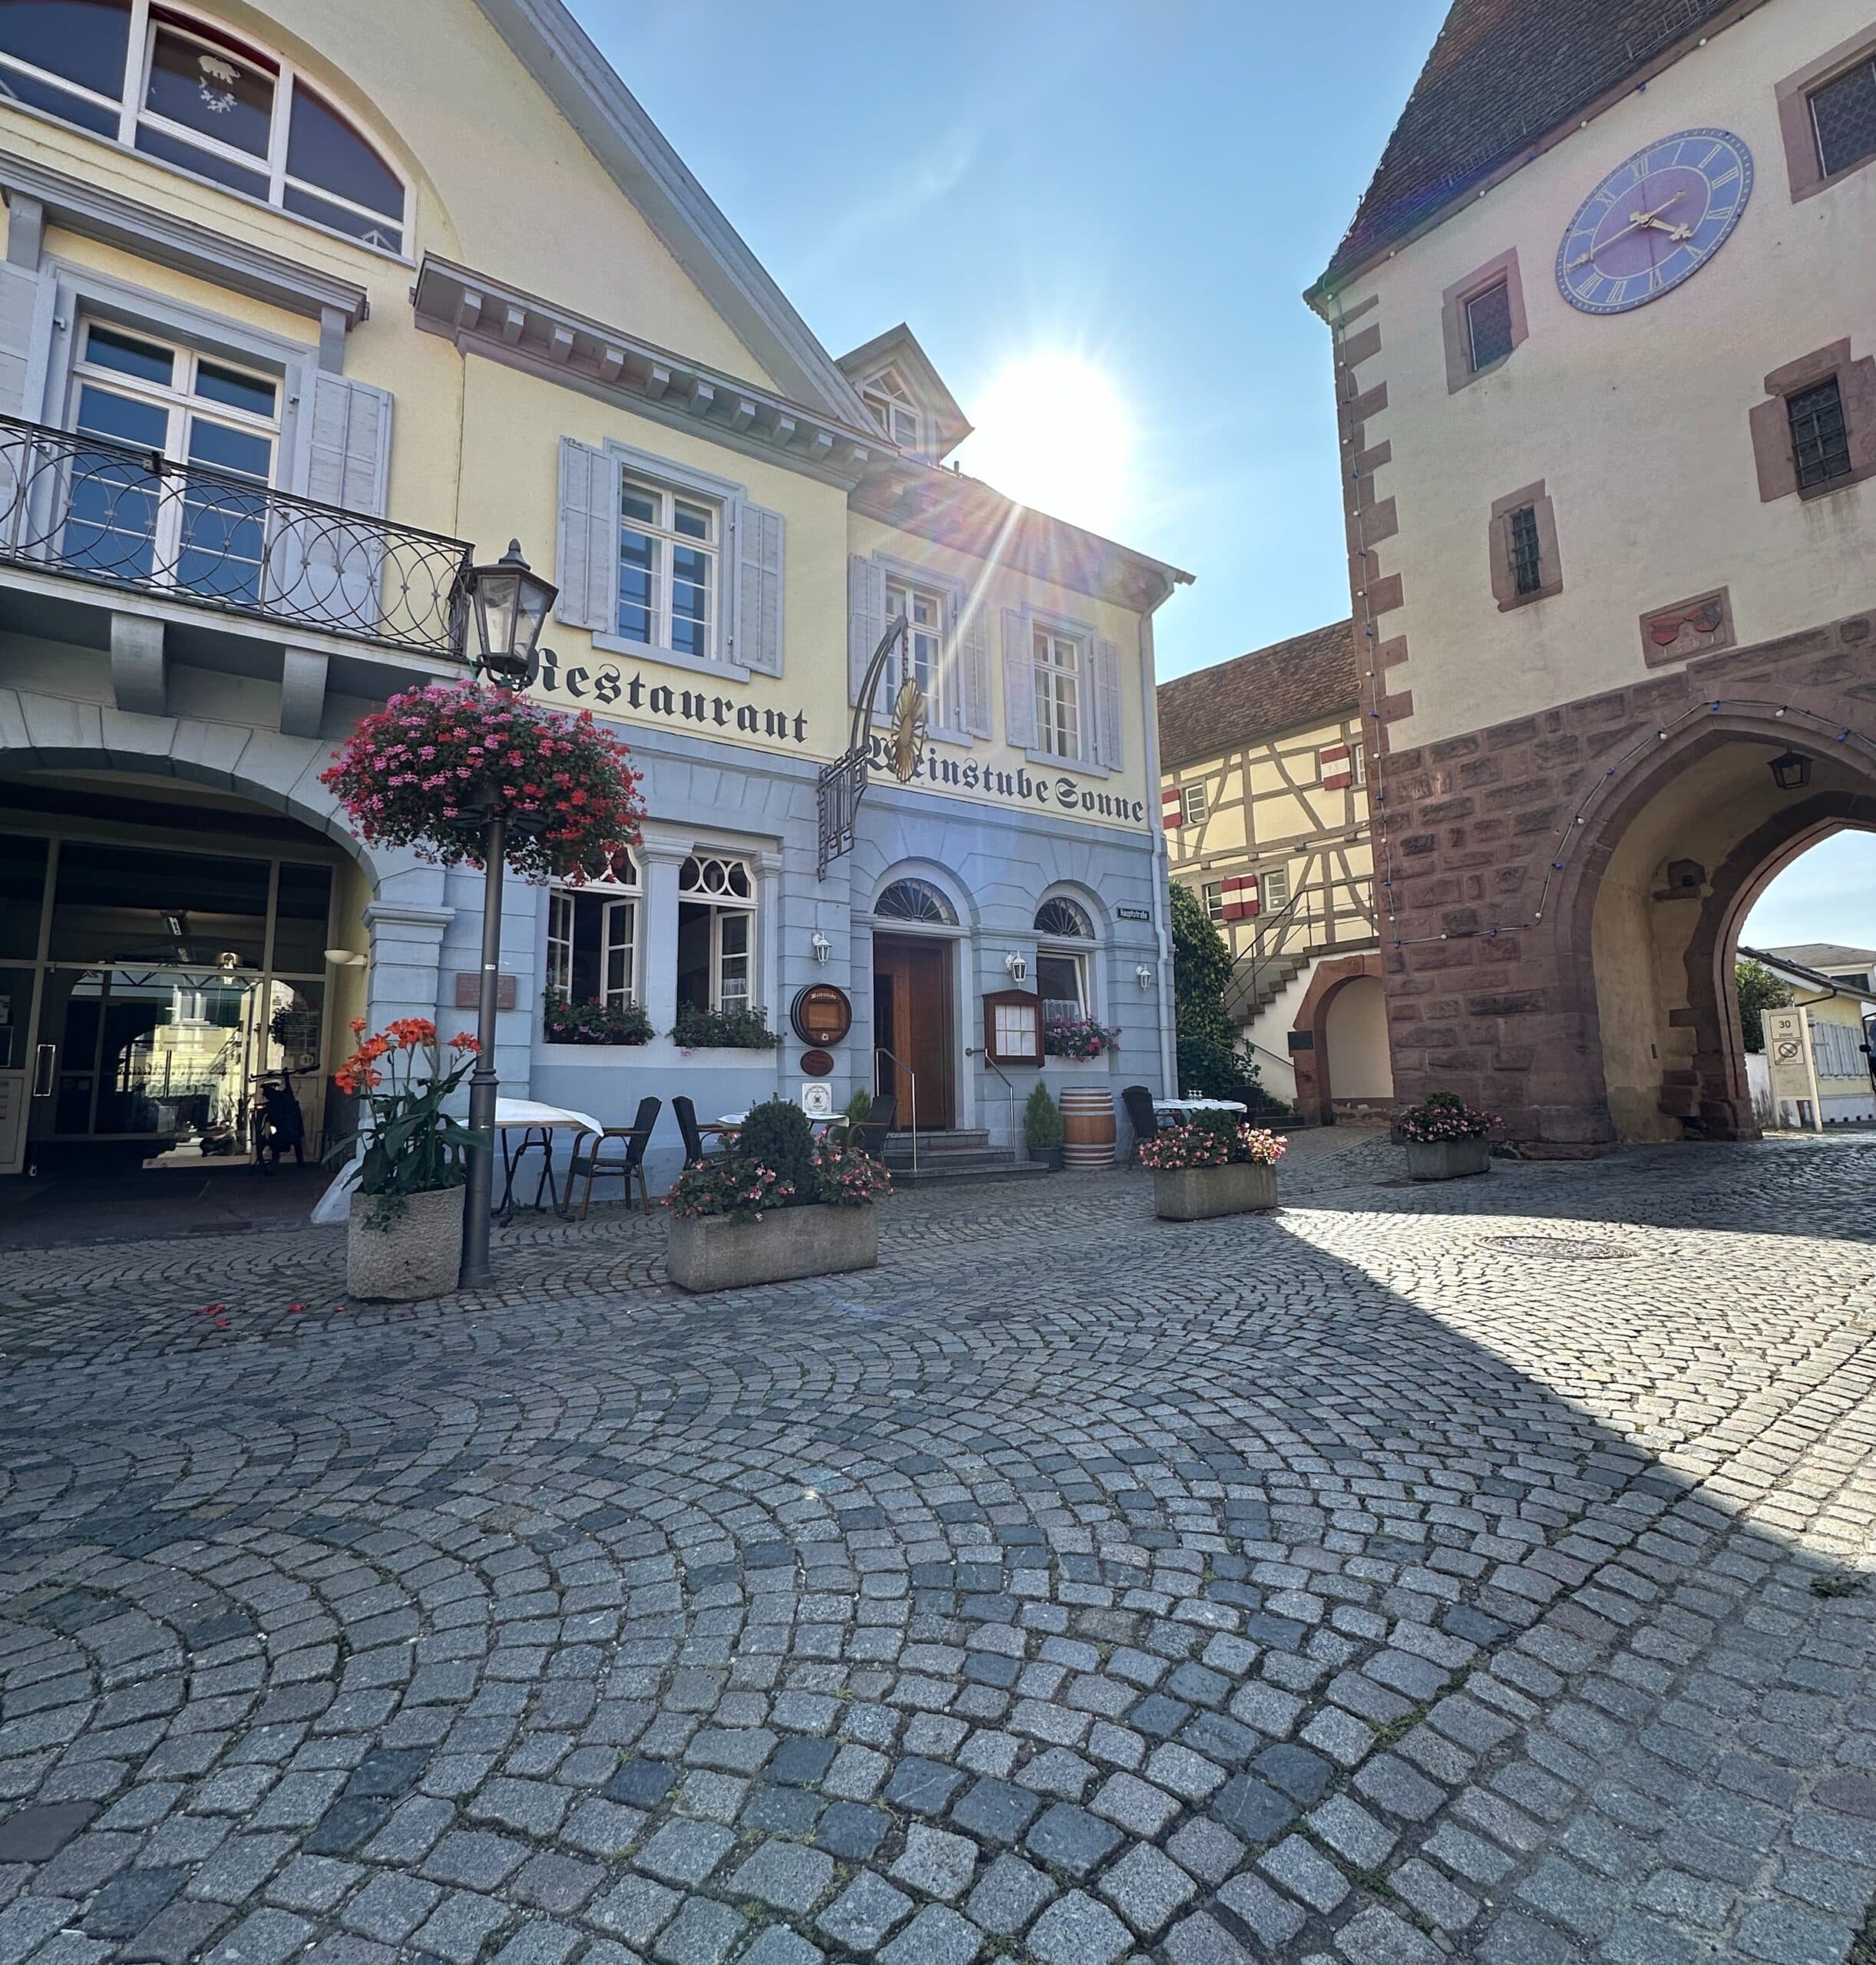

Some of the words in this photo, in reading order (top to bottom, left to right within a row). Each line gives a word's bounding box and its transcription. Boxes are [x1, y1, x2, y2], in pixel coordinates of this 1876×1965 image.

[526, 648, 808, 743] Restaurant
[1055, 777, 1144, 822] Sonne
[1779, 1020, 1791, 1029] 30
